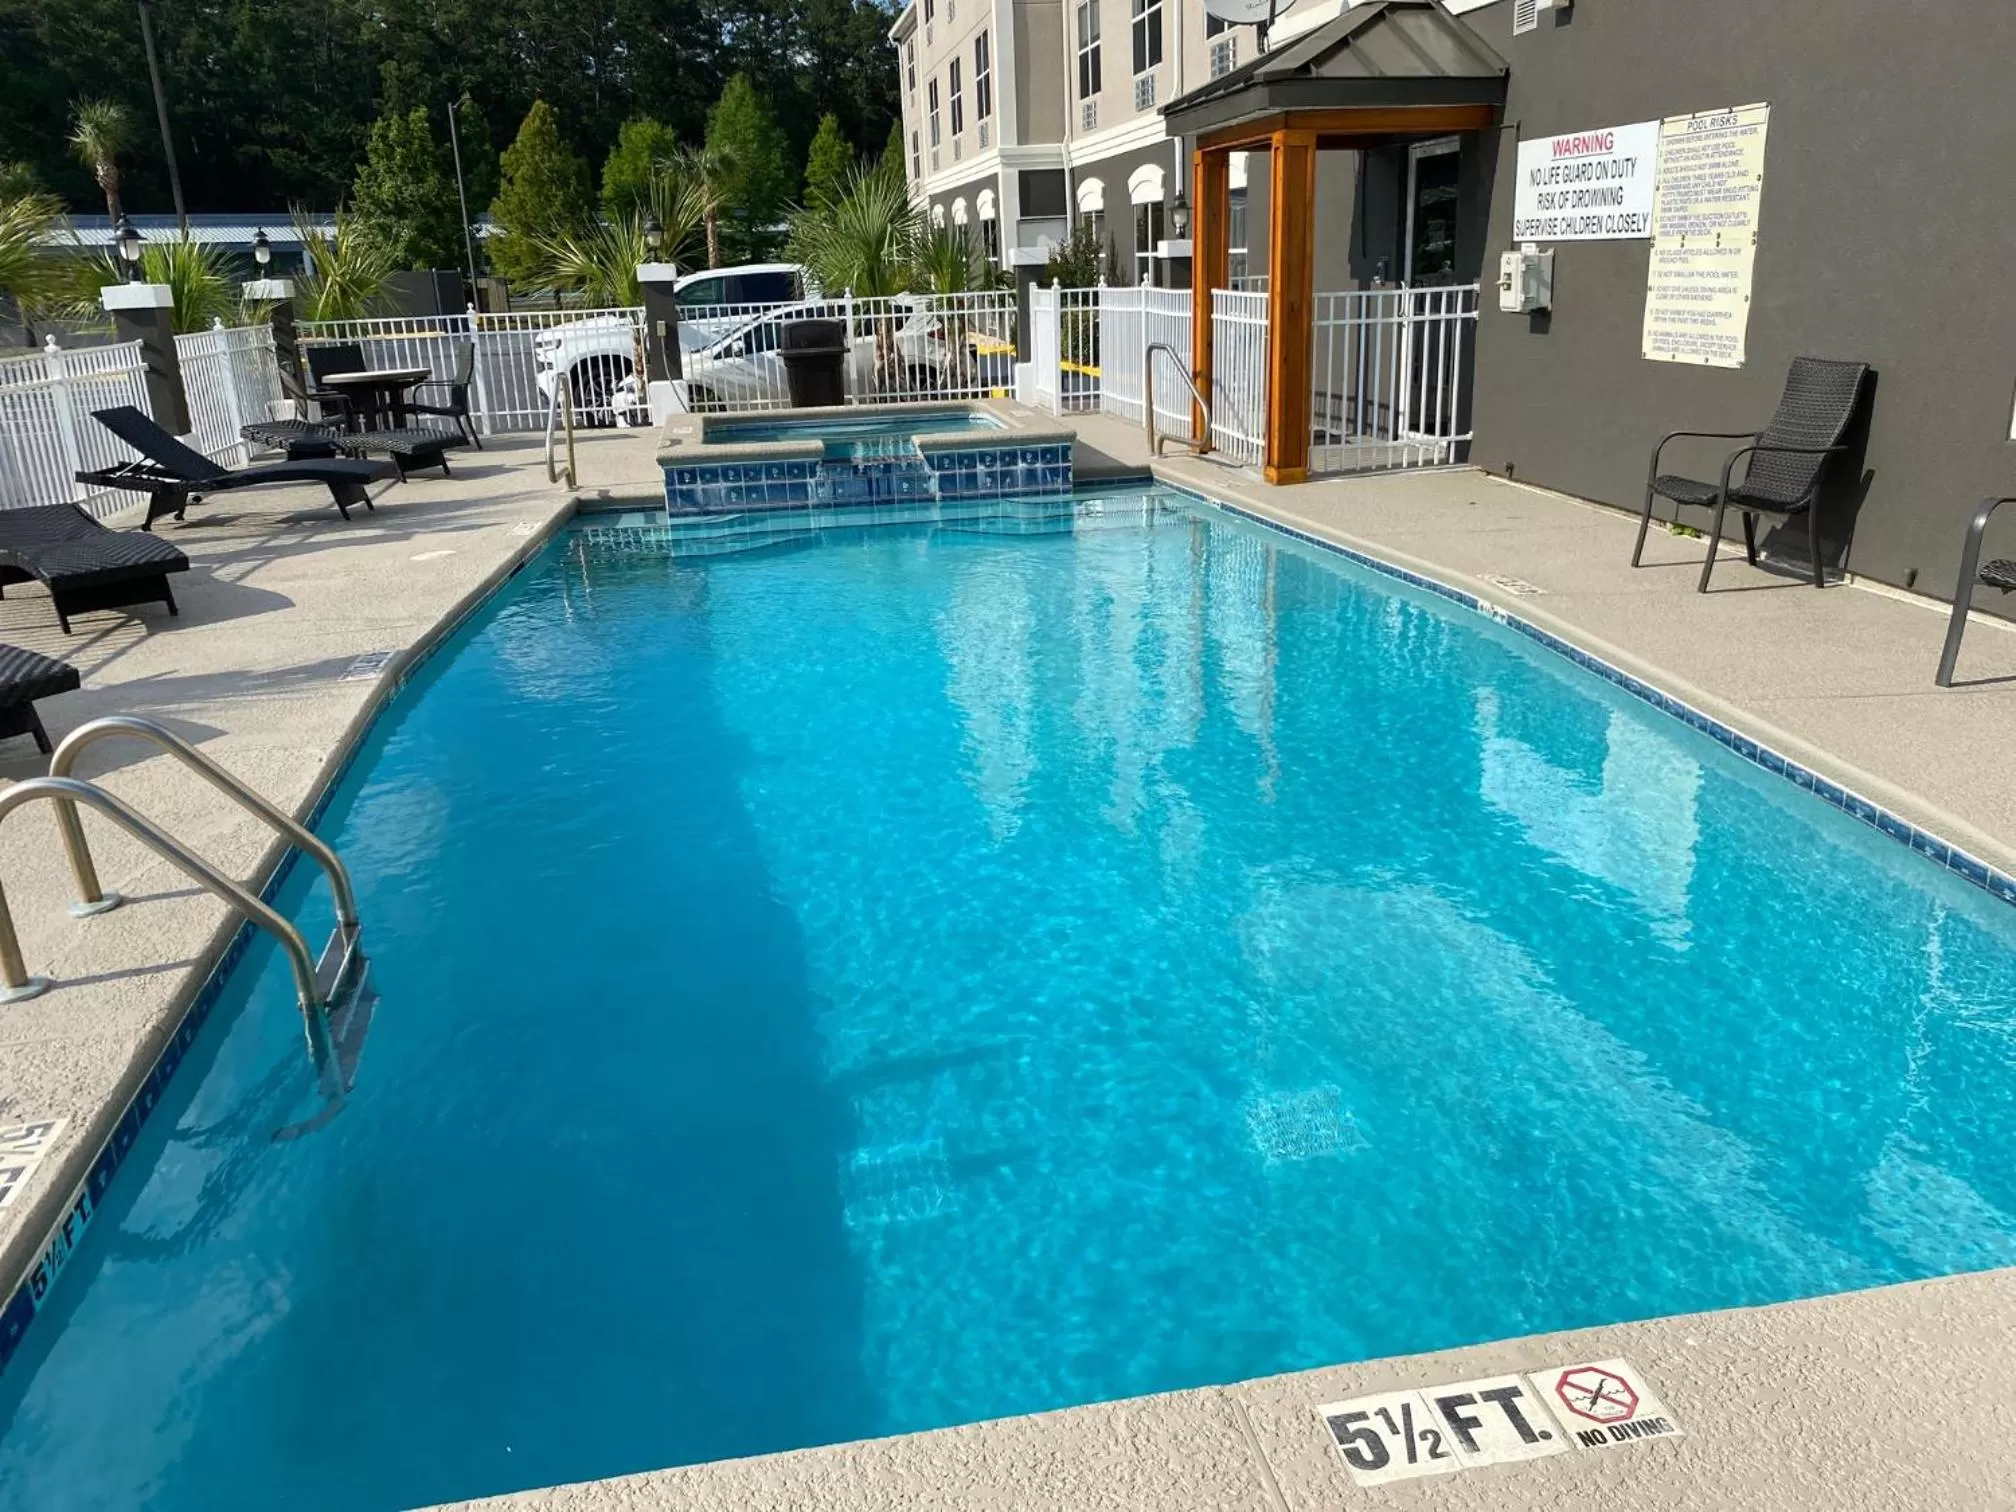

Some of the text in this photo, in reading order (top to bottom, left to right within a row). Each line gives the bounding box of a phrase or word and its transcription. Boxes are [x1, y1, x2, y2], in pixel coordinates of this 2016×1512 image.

[1687, 115, 1738, 131] POOL RISKS
[1552, 132, 1614, 157] WARNING
[1530, 168, 1541, 186] NO
[1543, 166, 1560, 185] LIFE
[1562, 162, 1593, 184] GUARD
[1595, 160, 1610, 180] ON
[1611, 157, 1637, 178] DUTY
[1537, 186, 1624, 211] RISK OF DROWNING
[1515, 218, 1558, 237] SUPERVISE
[1559, 214, 1603, 235] CHILDREN
[1605, 212, 1650, 234] CLOSELY
[1435, 1386, 1553, 1453] FT.
[1576, 1416, 1675, 1448] NO DIVING
